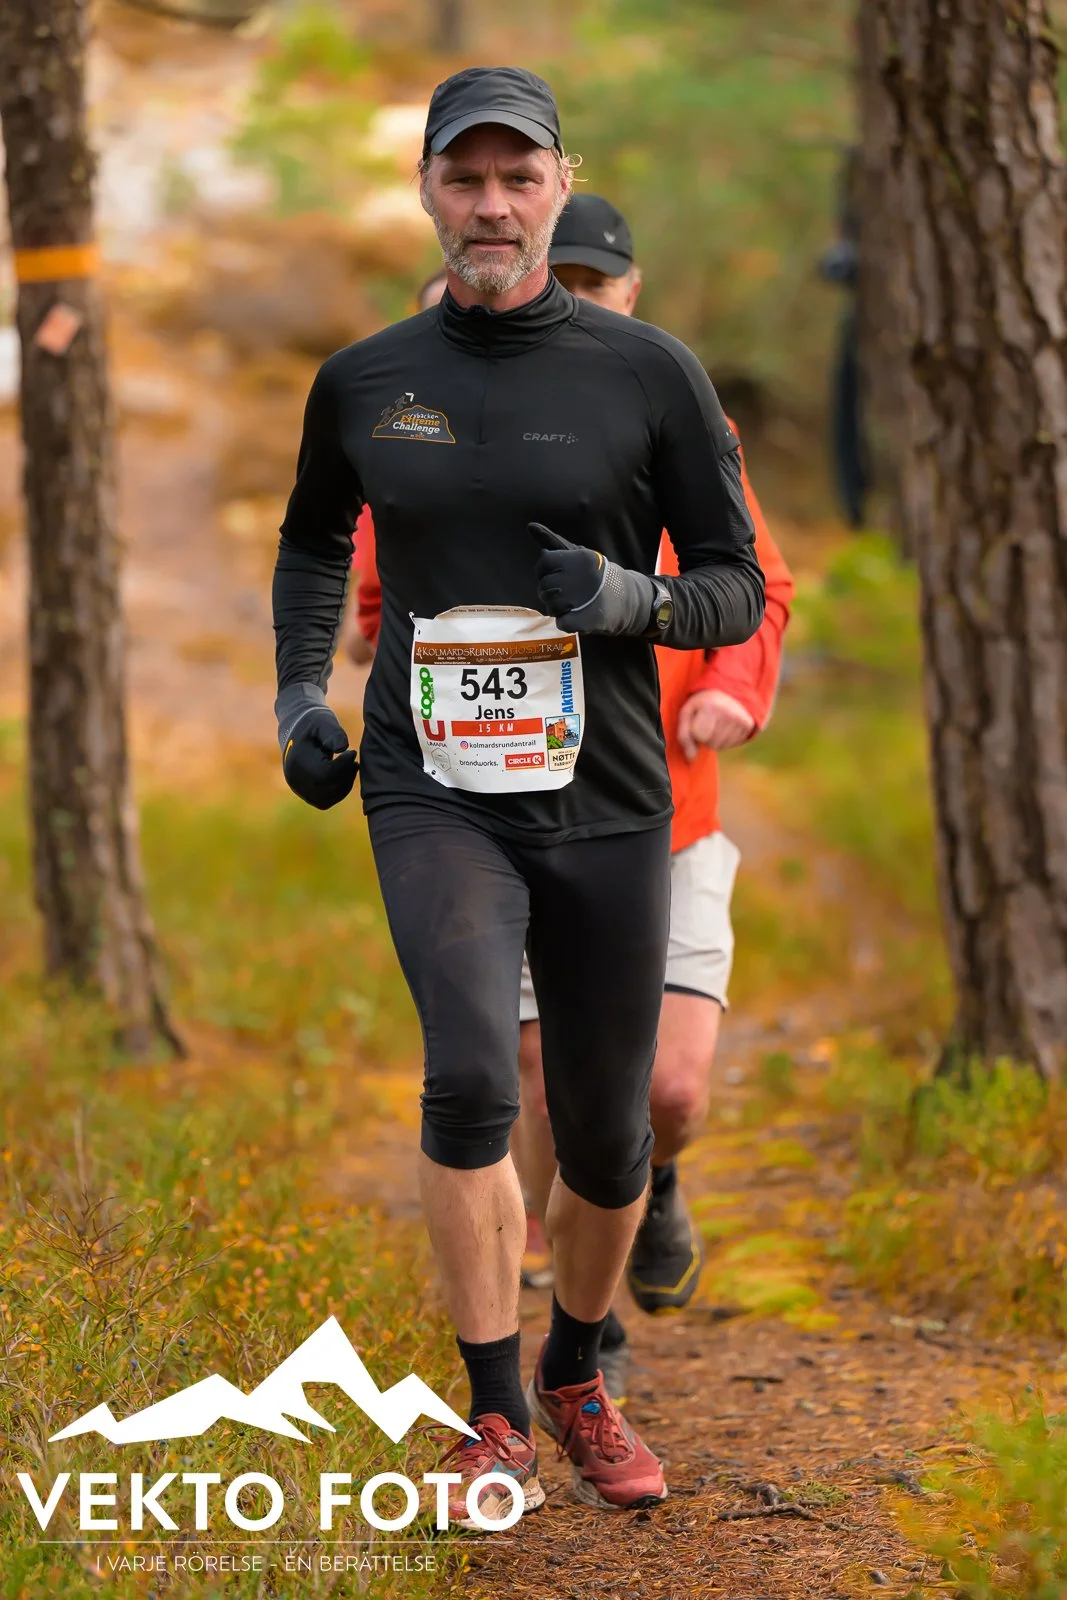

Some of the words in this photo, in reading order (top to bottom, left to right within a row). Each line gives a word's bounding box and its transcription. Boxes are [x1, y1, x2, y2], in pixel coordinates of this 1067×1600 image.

[400, 415, 440, 427] Extreme
[392, 422, 441, 435] Challenge
[522, 432, 566, 442] CRAFT
[460, 666, 528, 701] 543
[560, 660, 574, 714] Aktivitus
[419, 666, 434, 720] coop
[475, 704, 515, 720] Jens
[478, 724, 491, 733] 15
[499, 723, 514, 732] KM
[470, 740, 536, 749] kolmardsrundantrail
[508, 757, 532, 765] CIRCLE
[533, 755, 541, 764] K
